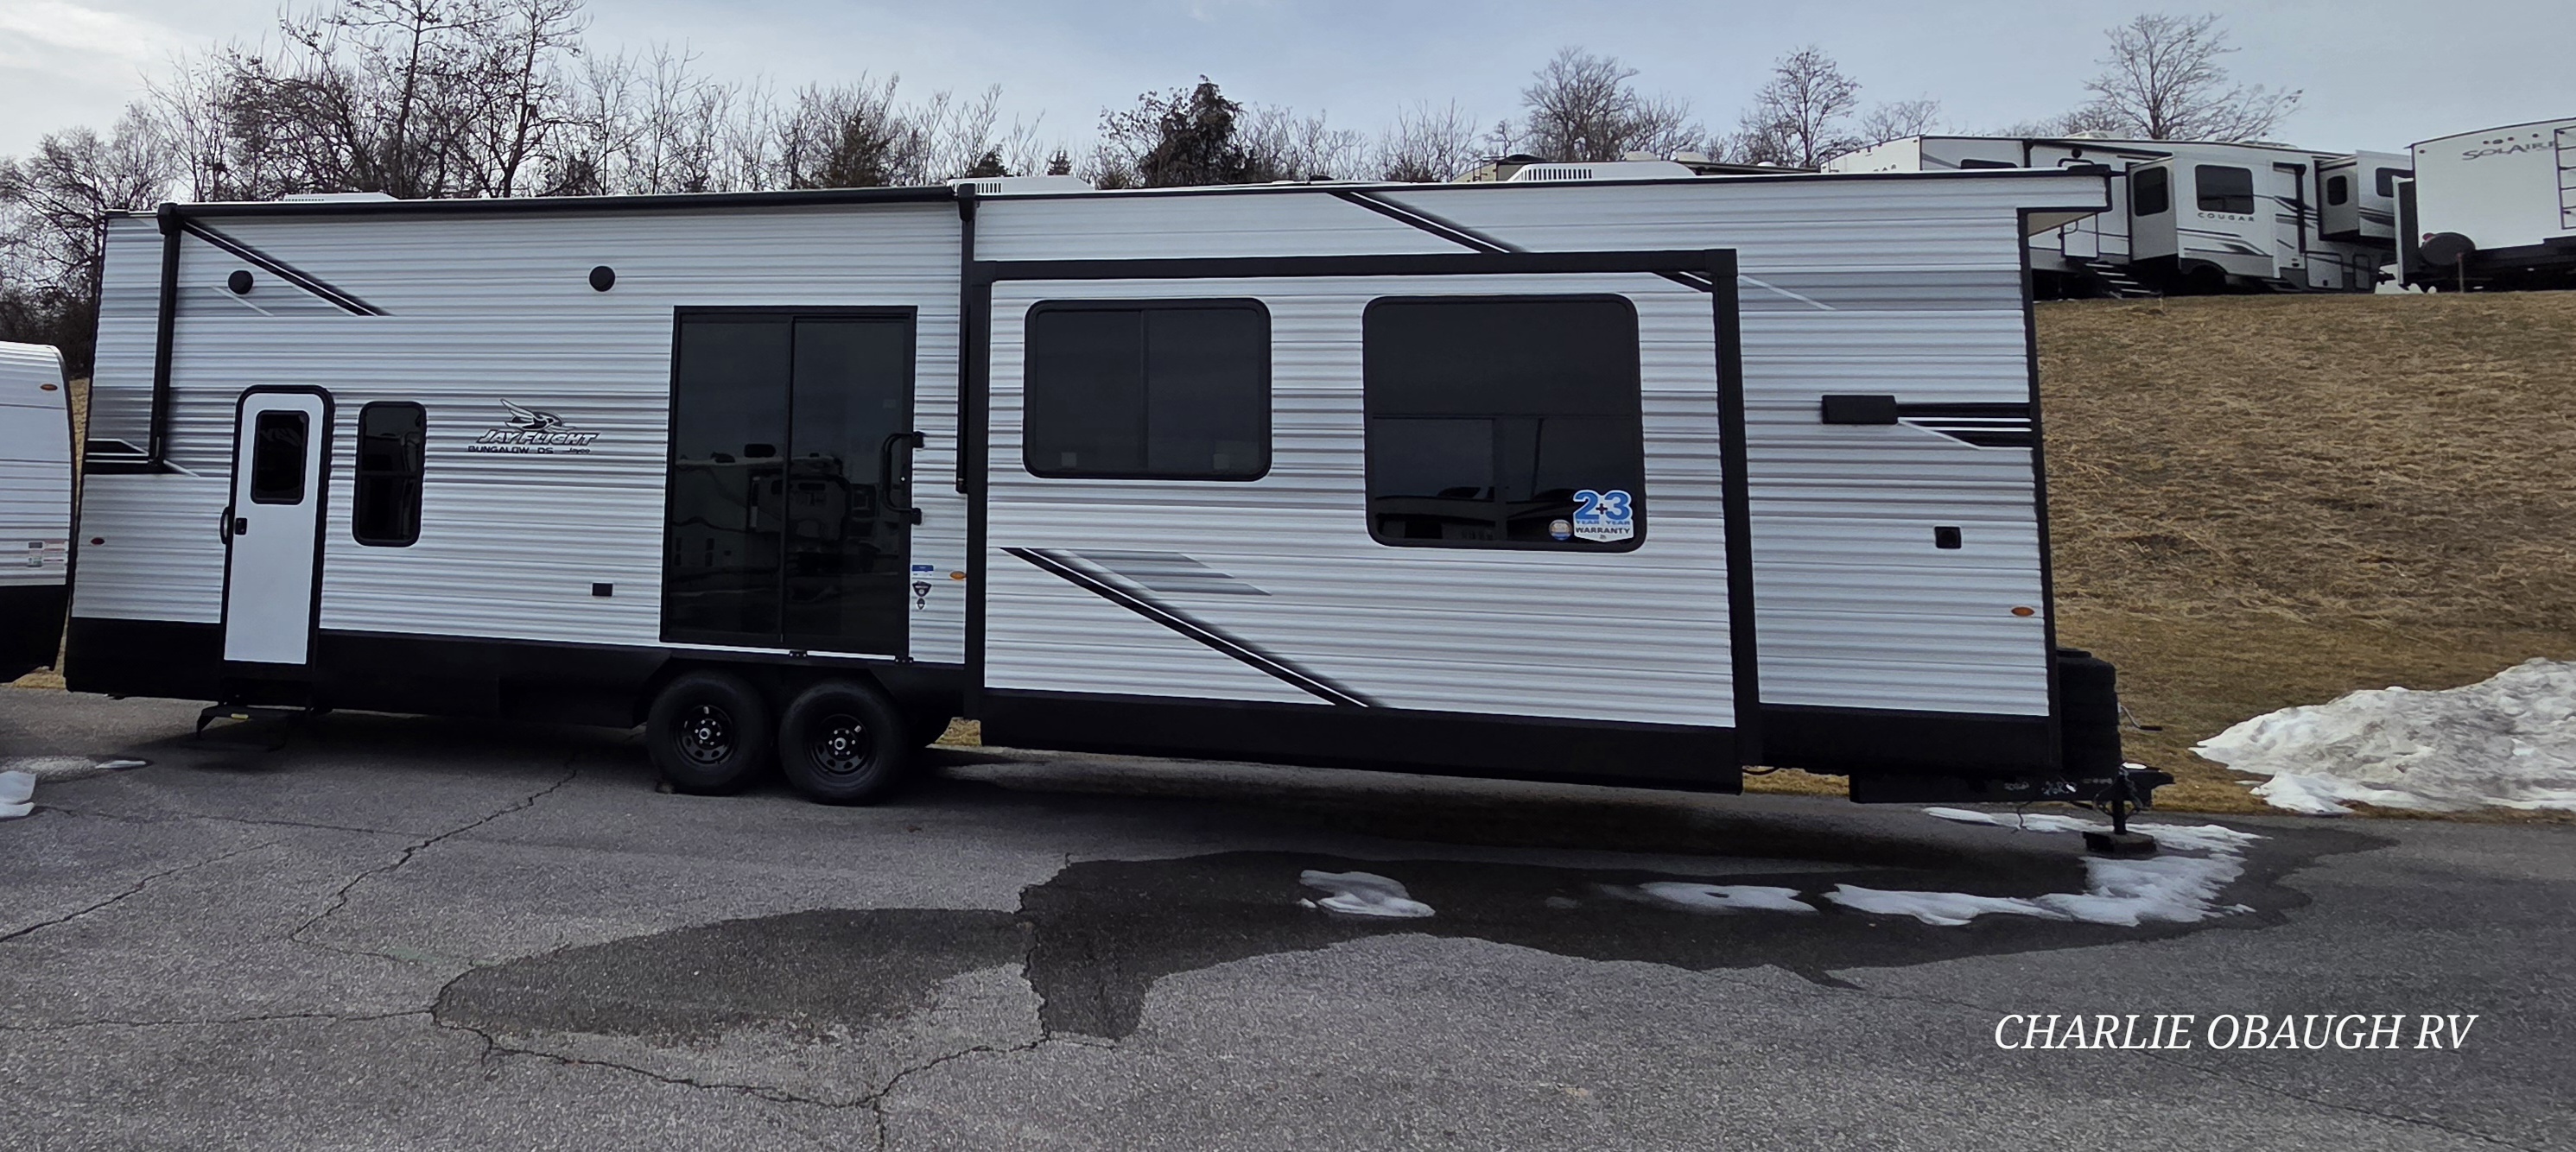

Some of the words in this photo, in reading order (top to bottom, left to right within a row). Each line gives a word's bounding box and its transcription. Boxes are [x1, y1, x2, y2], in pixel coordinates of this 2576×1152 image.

[2197, 212, 2255, 222] COUGAR
[477, 428, 518, 444] JAY
[518, 430, 600, 446] FLIGHT
[467, 445, 530, 454] BUNGALOW
